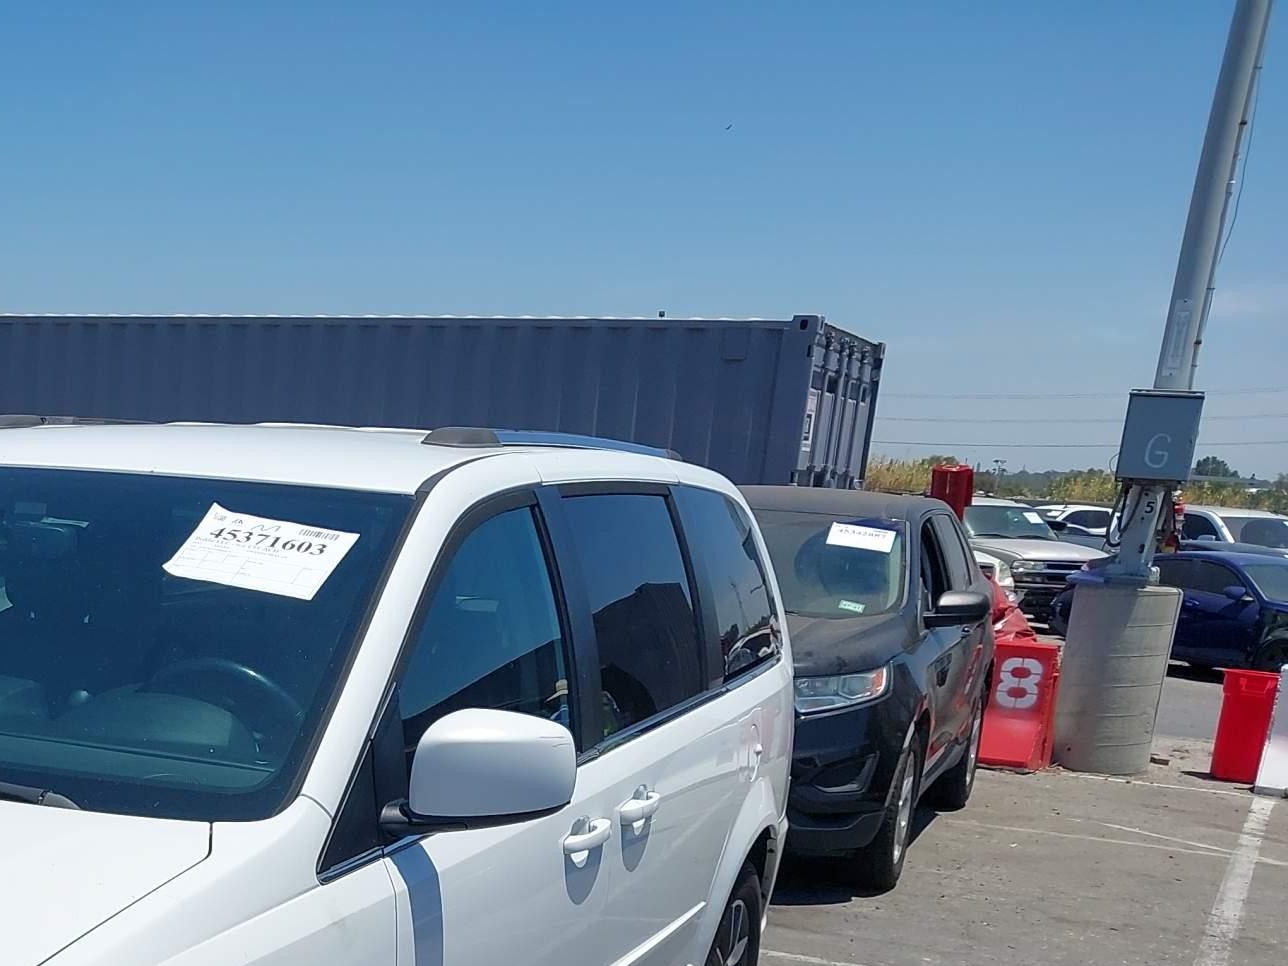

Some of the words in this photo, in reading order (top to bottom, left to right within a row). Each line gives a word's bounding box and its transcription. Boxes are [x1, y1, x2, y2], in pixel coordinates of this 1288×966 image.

[1143, 433, 1171, 469] G
[1144, 501, 1156, 514] 5
[209, 526, 329, 556] 45371603
[995, 657, 1044, 709] 8
